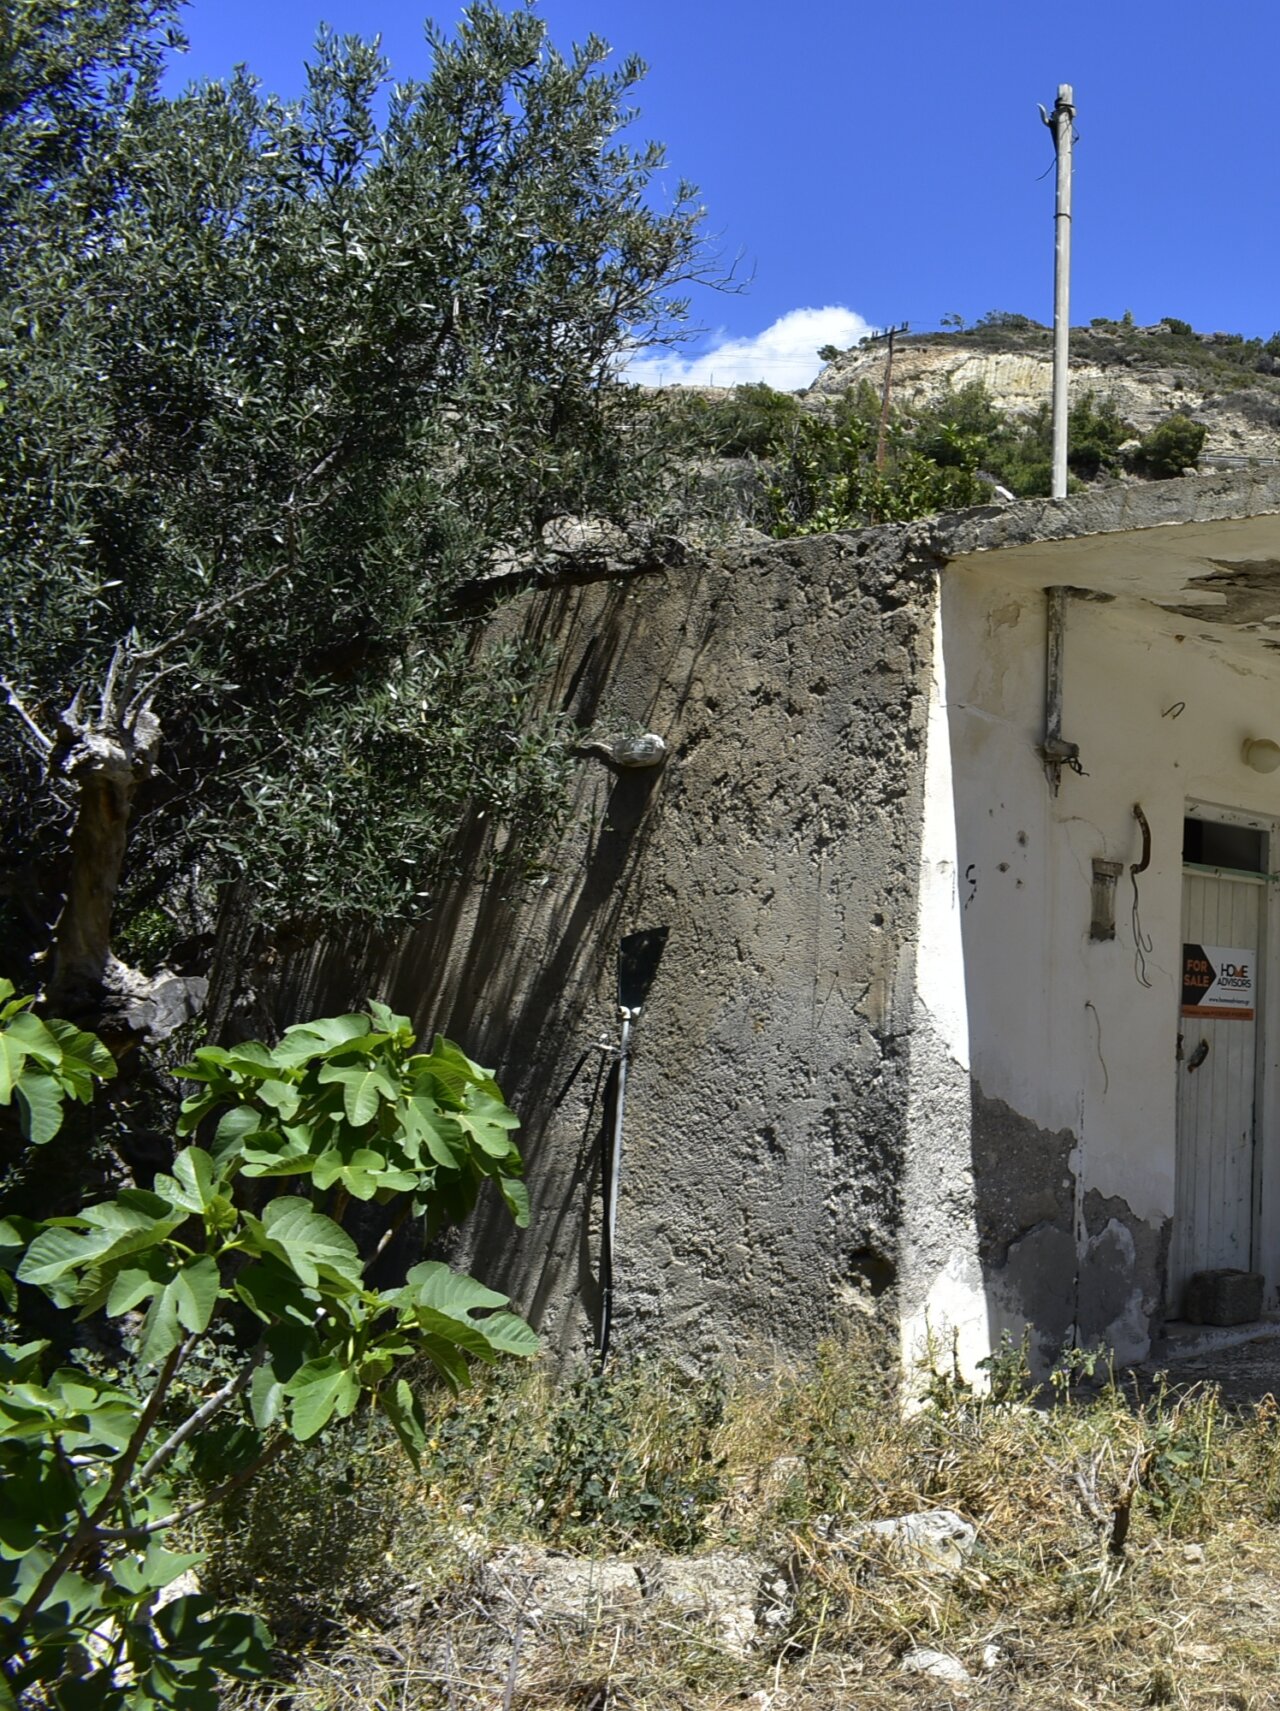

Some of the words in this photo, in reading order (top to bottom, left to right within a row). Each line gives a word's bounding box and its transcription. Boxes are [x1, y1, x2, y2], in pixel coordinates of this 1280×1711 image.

[1187, 960, 1208, 972] FOR
[1220, 963, 1248, 978] HOME
[1184, 975, 1209, 986] SALE
[1217, 978, 1251, 988] ADVISORS
